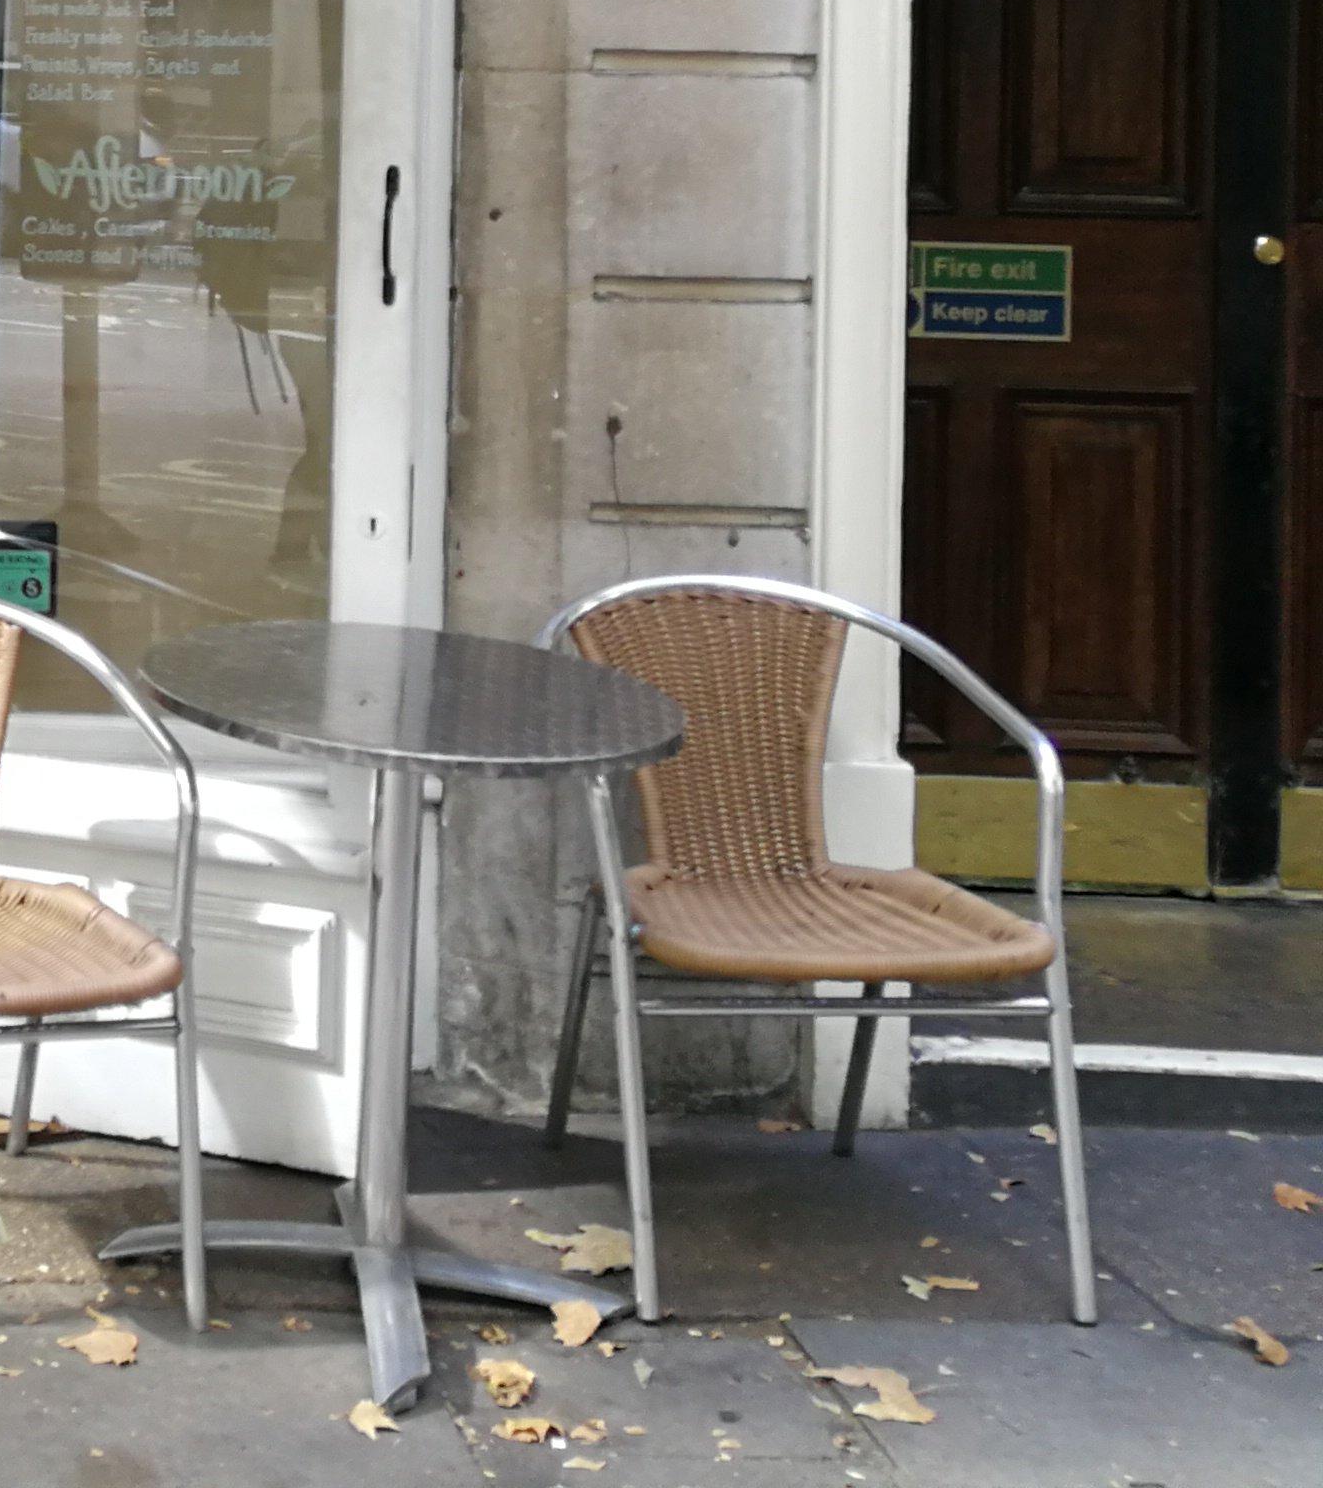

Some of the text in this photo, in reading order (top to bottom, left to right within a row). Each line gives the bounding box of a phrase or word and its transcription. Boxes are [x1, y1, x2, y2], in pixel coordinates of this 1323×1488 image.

[57, 134, 264, 212] Afternoon
[22, 243, 85, 264] Scones
[932, 256, 1037, 281] Fire exit
[931, 301, 1049, 325] Keep clear
